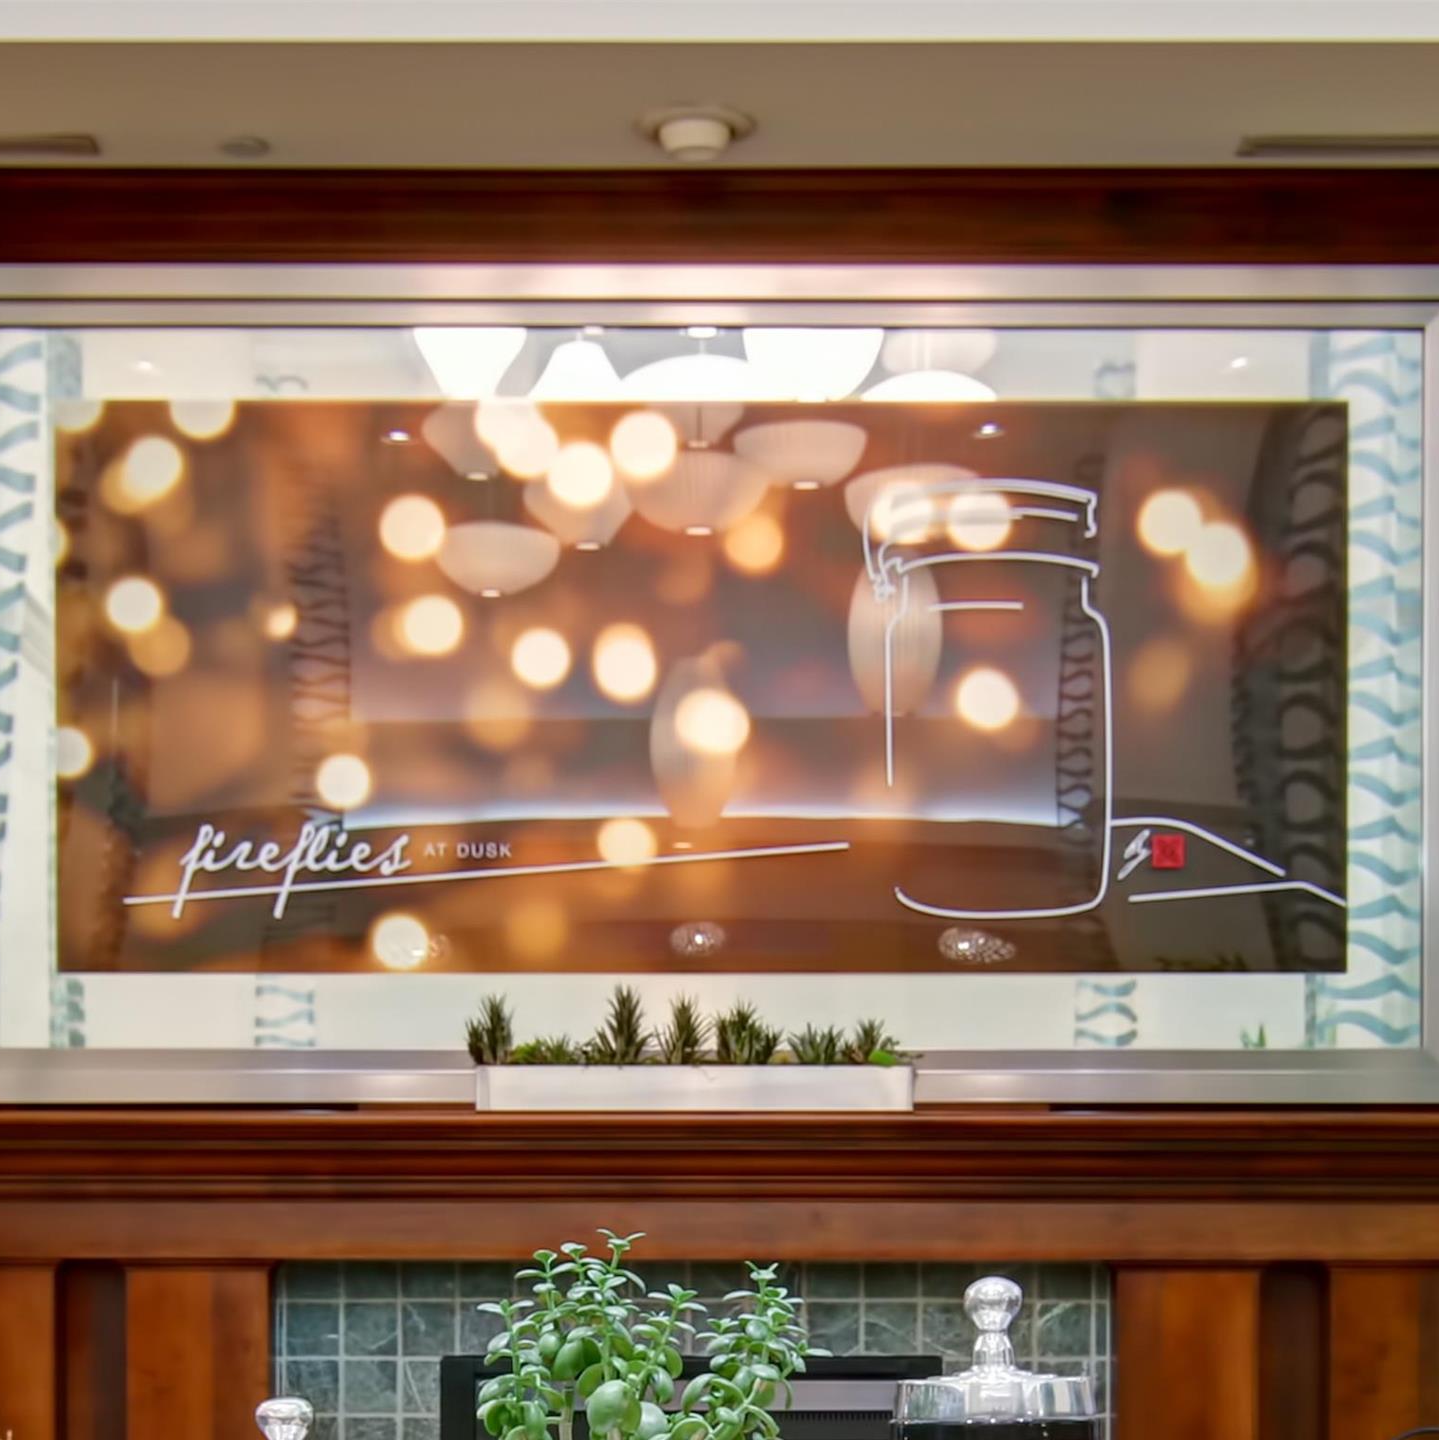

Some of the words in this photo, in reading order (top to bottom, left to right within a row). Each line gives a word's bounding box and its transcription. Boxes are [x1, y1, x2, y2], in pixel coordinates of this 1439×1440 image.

[172, 823, 411, 919] fireflies
[423, 842, 447, 857] AT
[457, 842, 512, 858] DUSK
